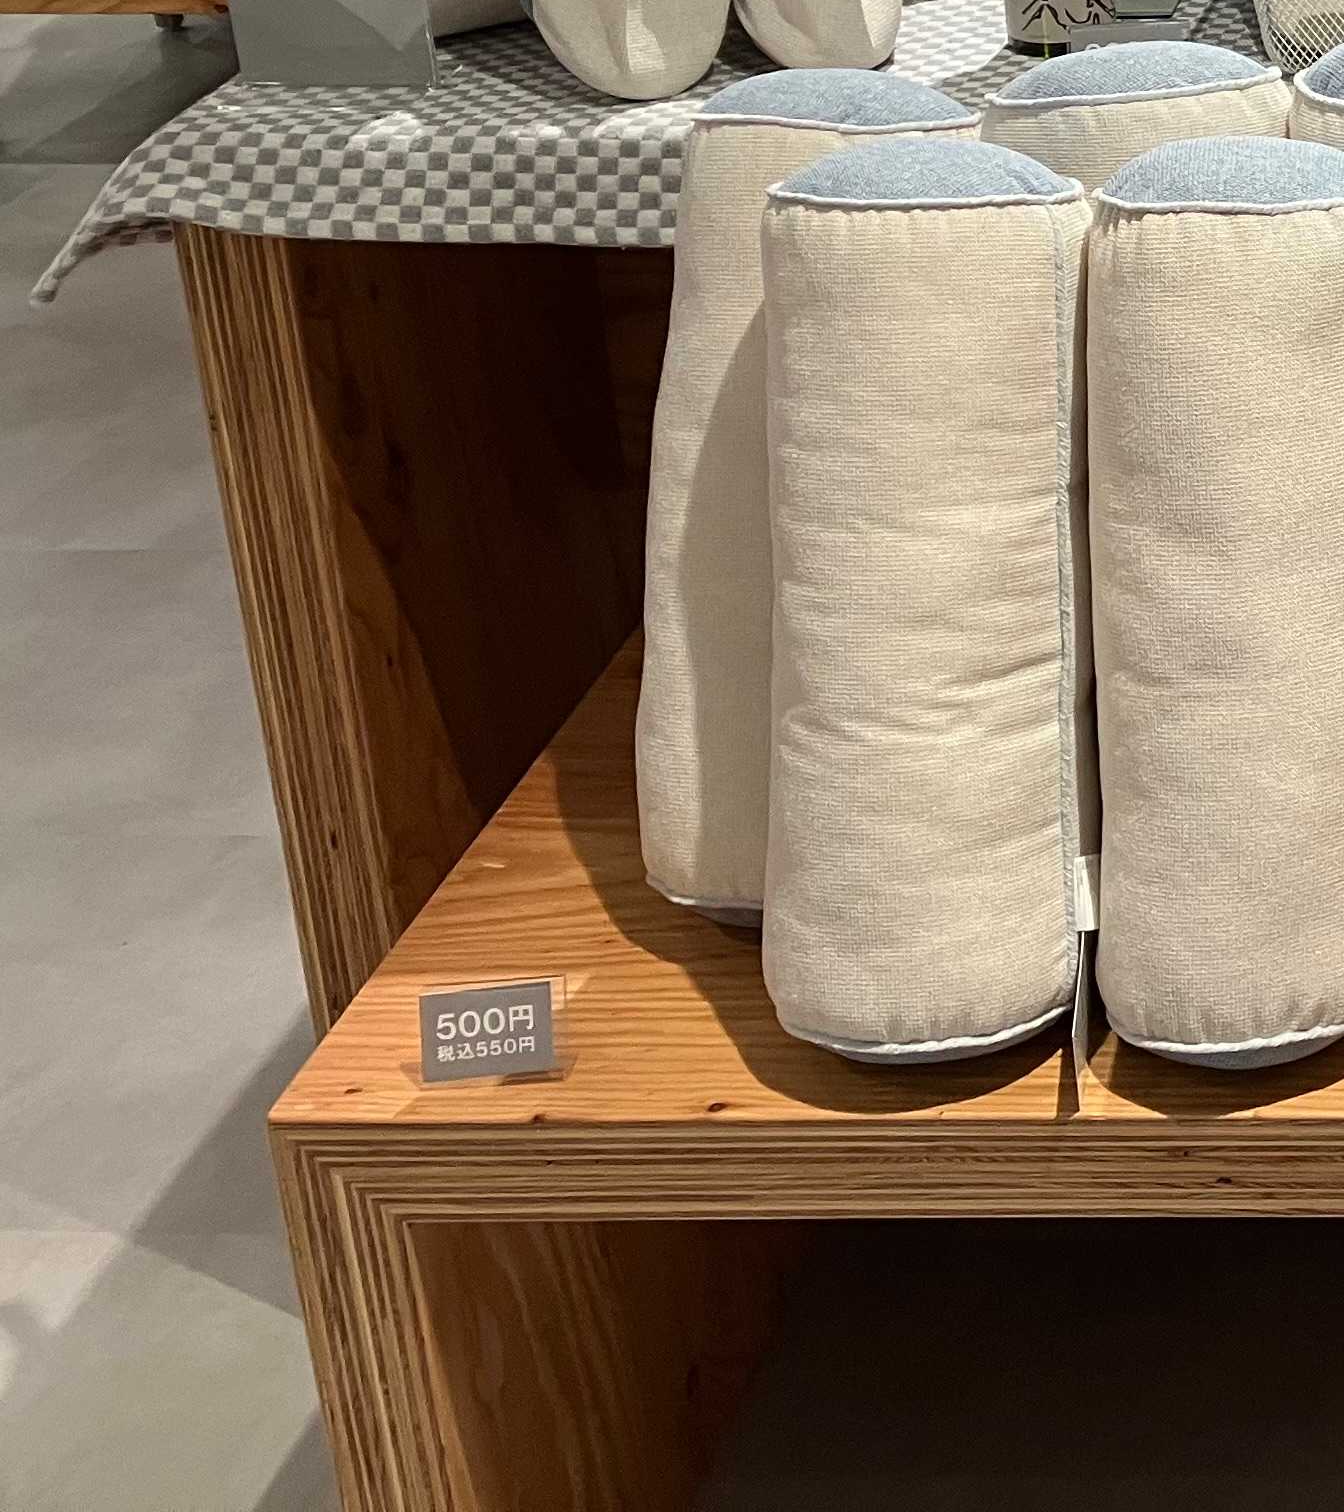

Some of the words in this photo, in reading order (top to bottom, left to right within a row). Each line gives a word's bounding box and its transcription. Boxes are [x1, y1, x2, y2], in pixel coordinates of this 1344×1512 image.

[435, 1004, 534, 1040] 500円
[436, 1035, 536, 1062] 税込550円
